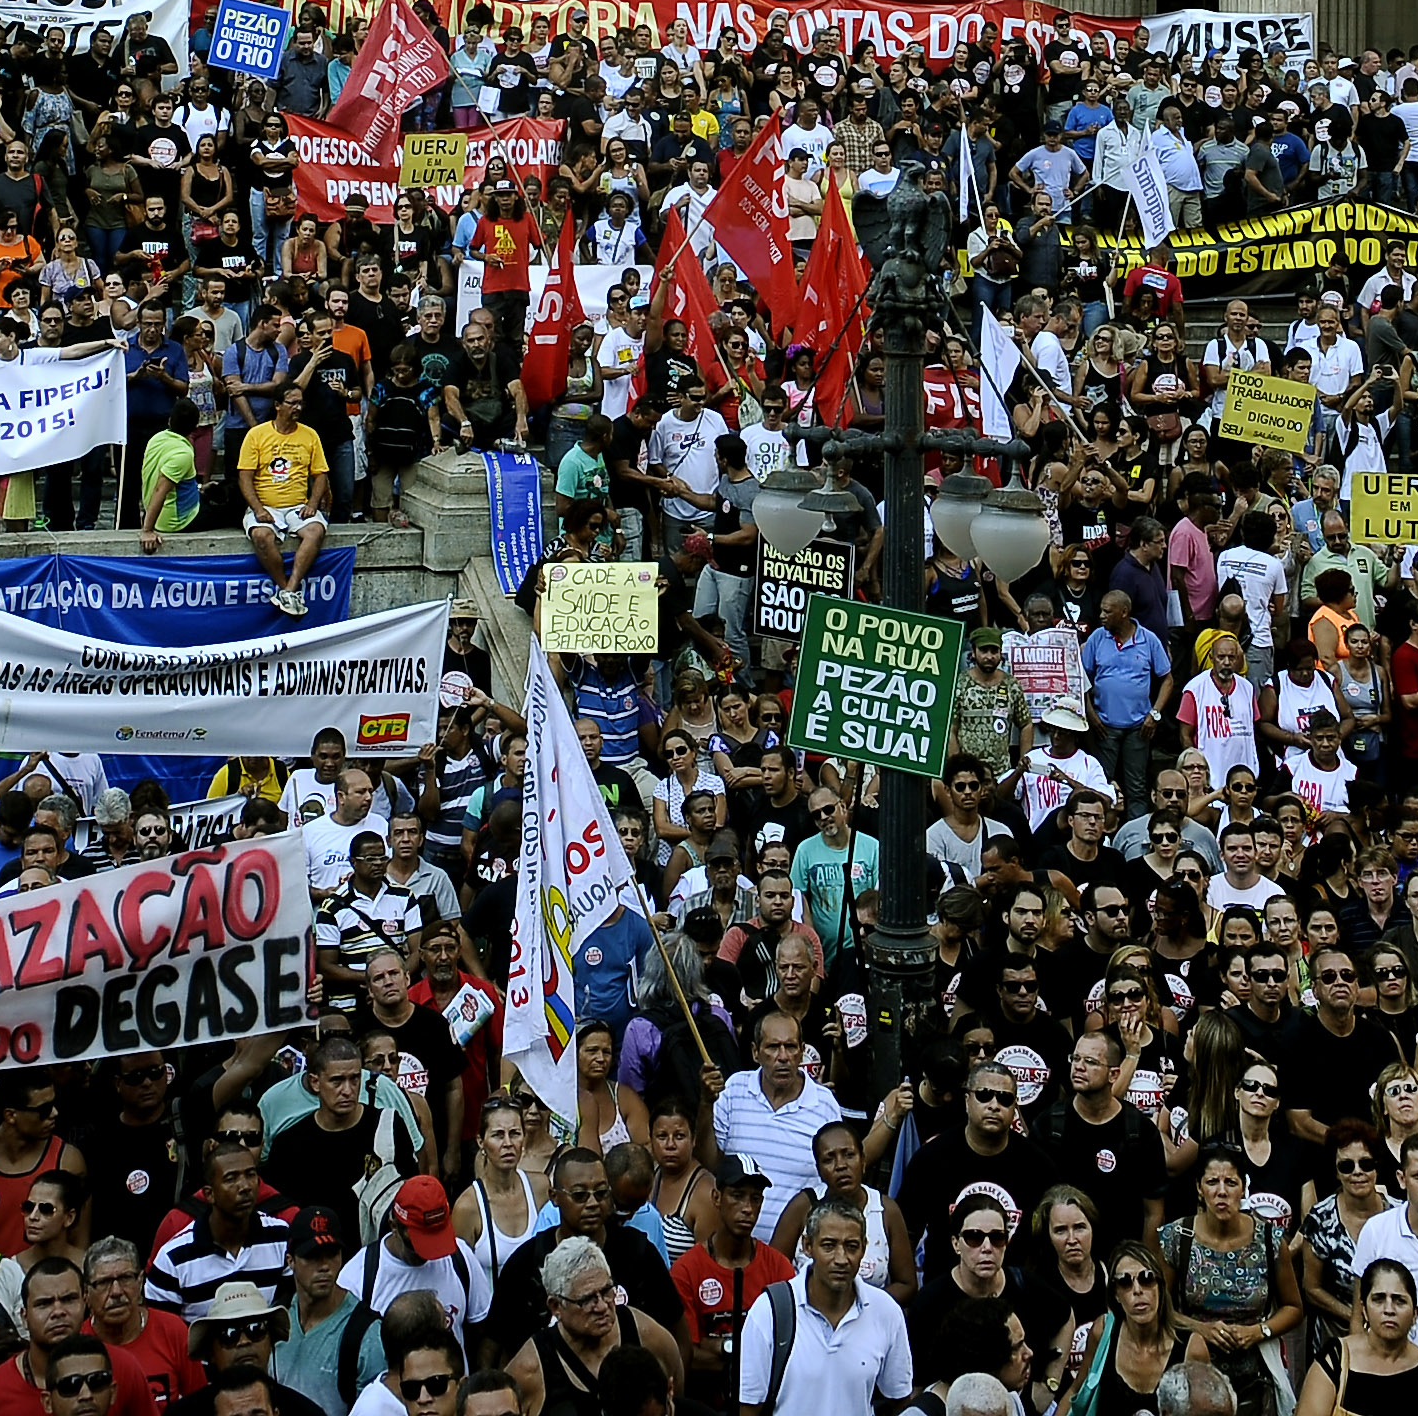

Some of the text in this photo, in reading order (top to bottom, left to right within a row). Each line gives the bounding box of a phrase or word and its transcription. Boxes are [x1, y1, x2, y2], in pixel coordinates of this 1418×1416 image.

[221, 27, 276, 48] QUEBROU
[223, 8, 280, 36] PEZÃO
[1165, 18, 1311, 58] MUSPE
[216, 40, 273, 69] O RIO
[18, 367, 111, 410] FIPERJ!
[1390, 499, 1411, 513] EM
[825, 608, 944, 650] O POVO
[821, 631, 940, 676] NA RUA
[816, 659, 937, 708] PEZÃO
[361, 718, 406, 737] CTB
[812, 690, 931, 732] A CULPA
[805, 709, 930, 764] É SUA!
[52, 926, 321, 1060] DEGASE!
